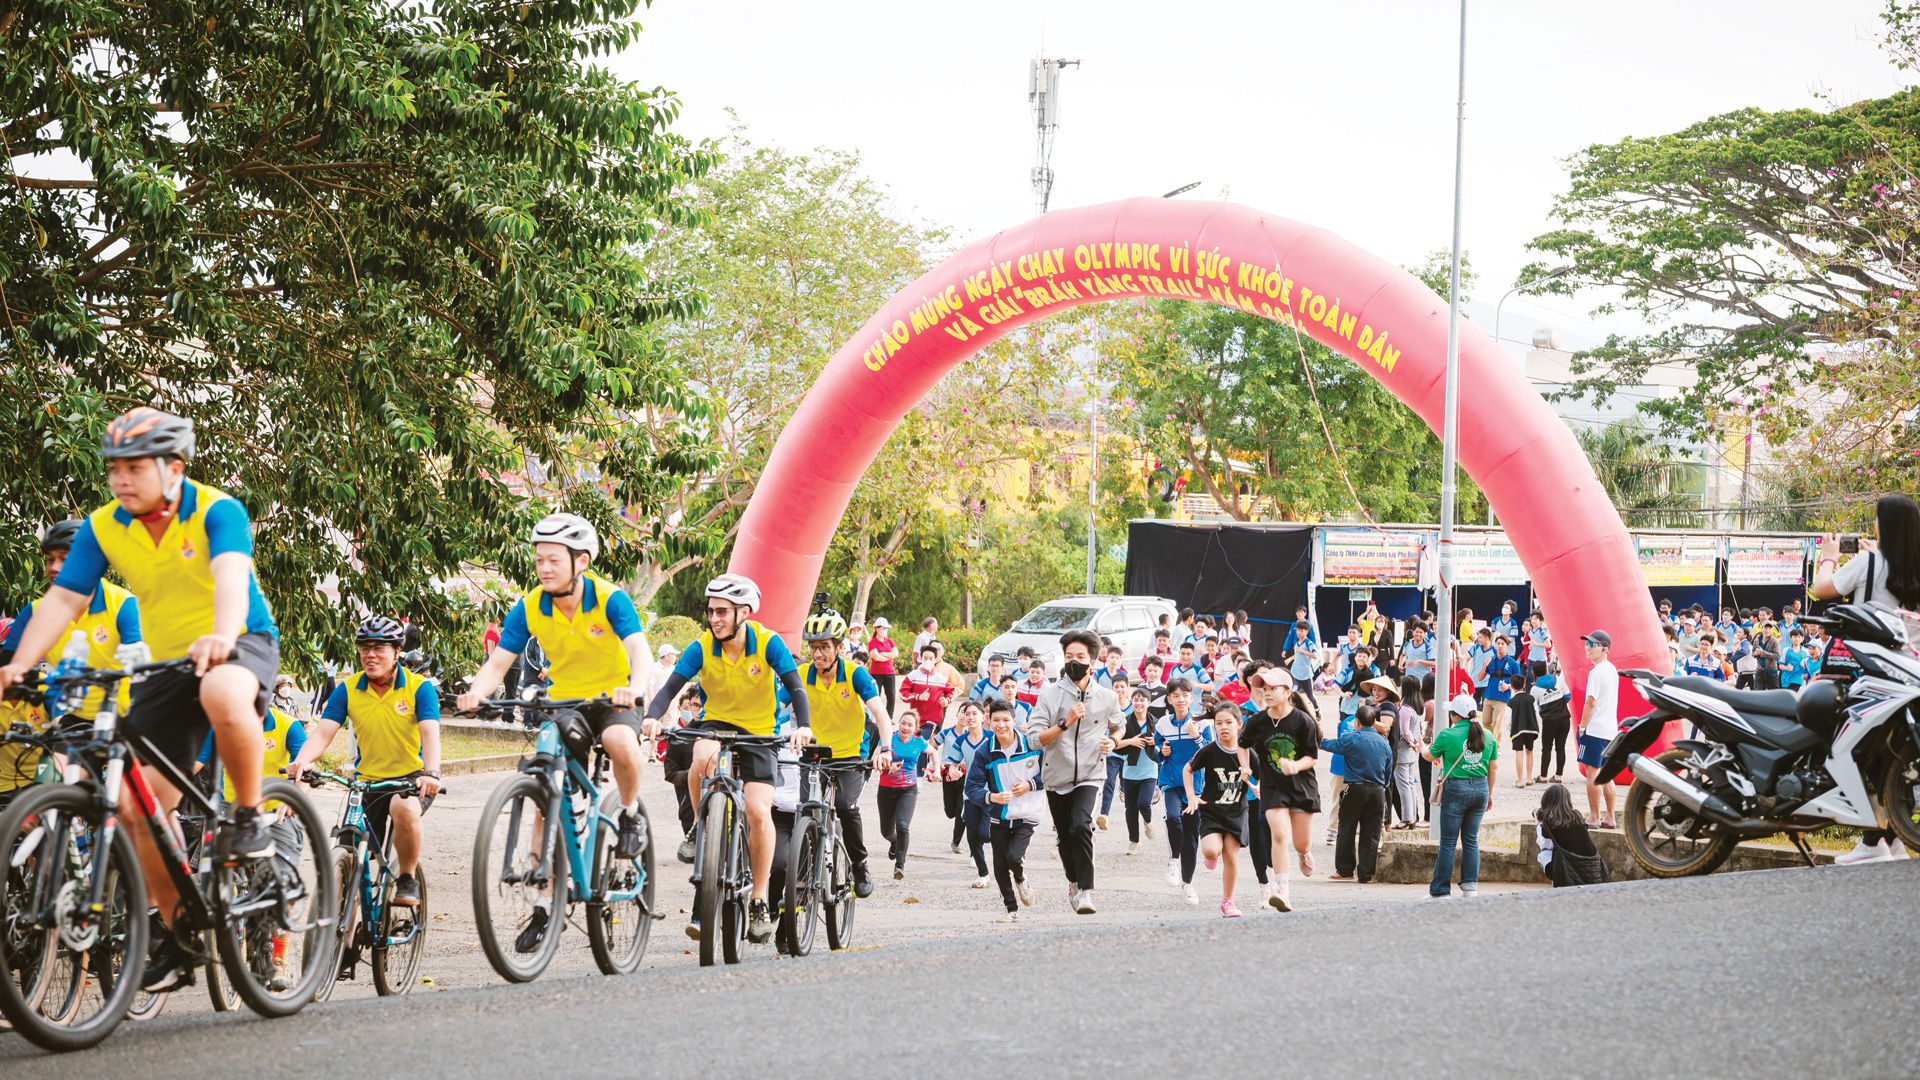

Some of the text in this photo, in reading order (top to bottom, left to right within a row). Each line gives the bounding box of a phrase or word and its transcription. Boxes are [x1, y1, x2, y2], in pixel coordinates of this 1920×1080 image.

[864, 320, 909, 371] CHÀO
[963, 260, 1013, 302] NGÀY
[1018, 248, 1065, 281] CHẠY
[1075, 242, 1161, 271] OLYMPIC
[1169, 240, 1189, 274] VÌ
[1299, 286, 1358, 341] TOÀN
[1357, 324, 1401, 373] DÂN
[944, 312, 985, 342] VÀ
[979, 293, 1024, 325] GIẢI
[1078, 271, 1142, 296] YÀNG
[1208, 284, 1260, 314] NĂM
